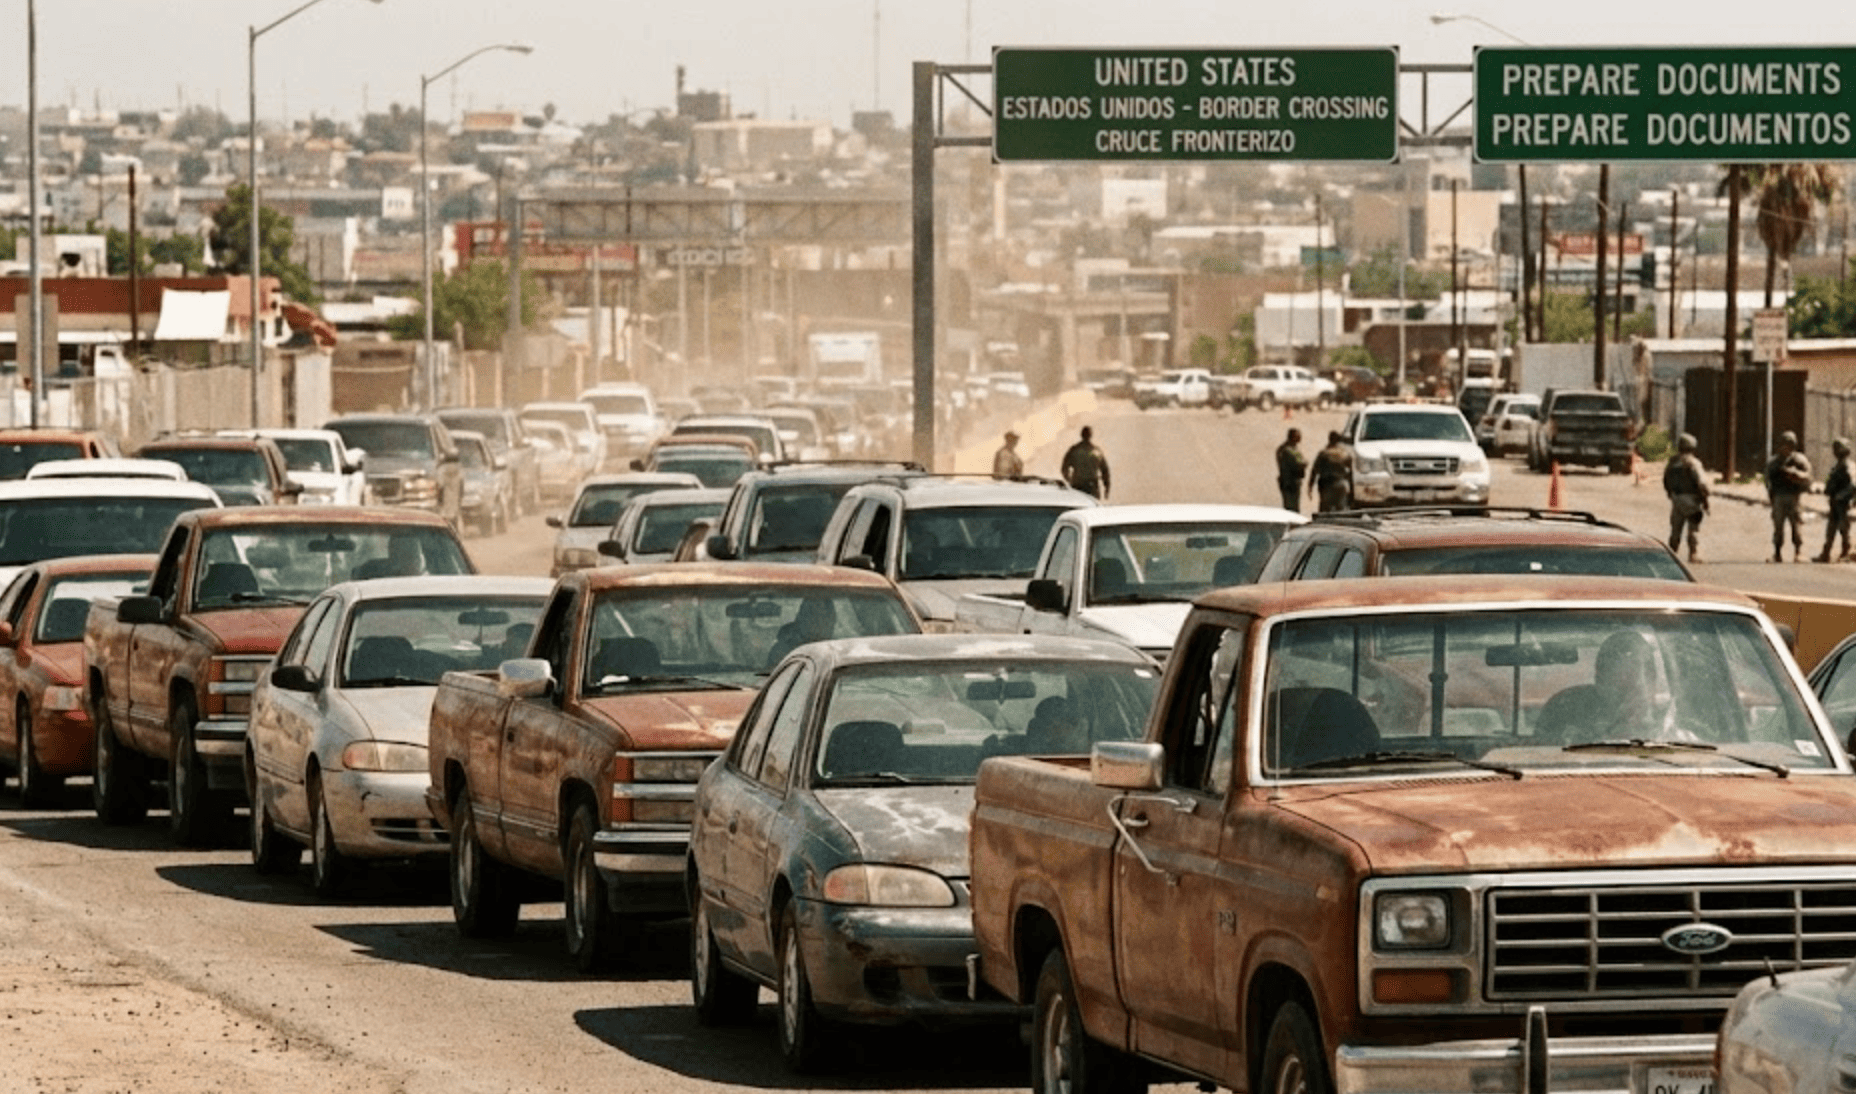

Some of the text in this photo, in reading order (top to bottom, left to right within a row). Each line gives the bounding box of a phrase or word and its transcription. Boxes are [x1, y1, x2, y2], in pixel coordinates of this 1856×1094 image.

[1095, 56, 1296, 87] UNITED STATES
[1503, 62, 1841, 96] PREPARE DOCUMENTS
[1002, 96, 1092, 120] ESTADOS
[1100, 96, 1176, 120] UNIDOS
[1199, 96, 1280, 120] BORDER
[1288, 96, 1389, 120] CROSSING
[1095, 129, 1296, 153] CRUCE FRONTERIZO
[1492, 112, 1851, 146] PREPARE DOCUMENTOS
